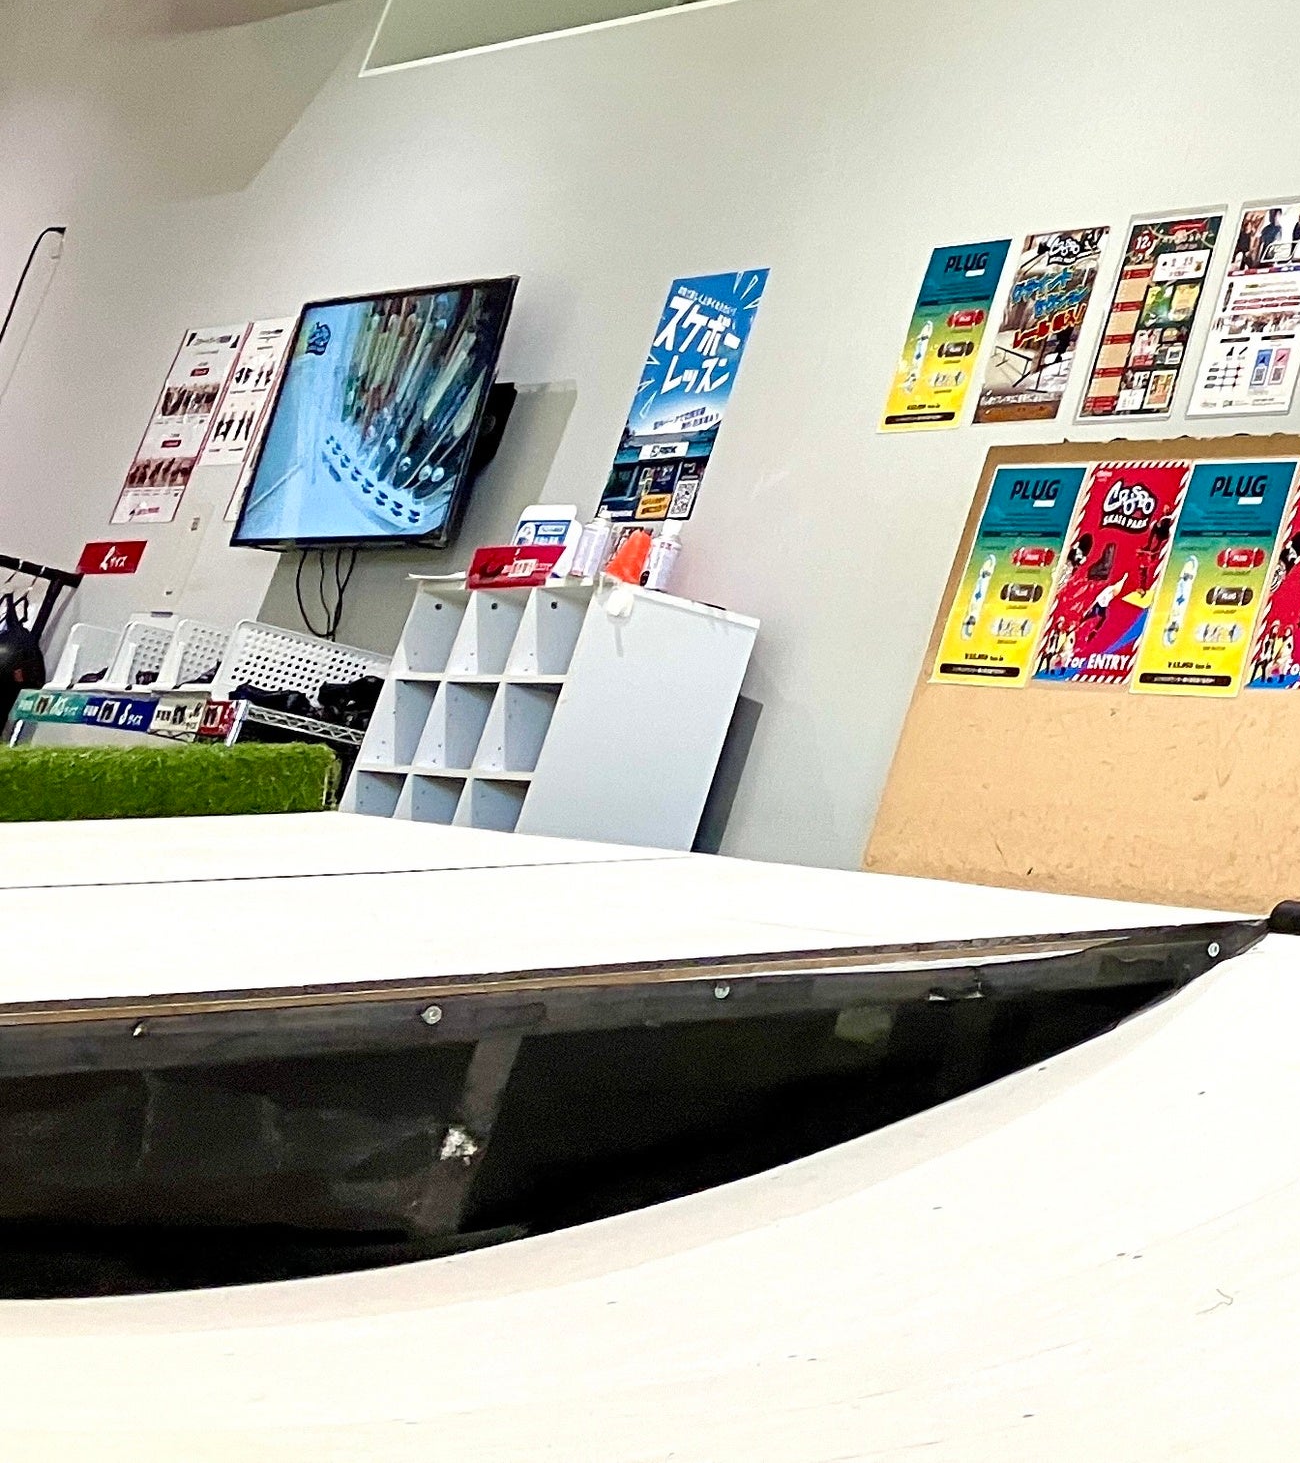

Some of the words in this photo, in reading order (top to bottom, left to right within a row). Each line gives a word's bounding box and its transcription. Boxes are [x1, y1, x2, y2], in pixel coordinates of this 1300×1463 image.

[944, 252, 990, 273] PLUG
[653, 295, 742, 357] スケボー
[661, 355, 730, 395] レッスン
[1010, 479, 1061, 500] PLUG
[1210, 475, 1268, 497] PLUG
[1102, 514, 1126, 527] SKATE
[1126, 516, 1149, 529] PARK
[1065, 653, 1084, 669] For
[1087, 654, 1129, 671] ENTRY
